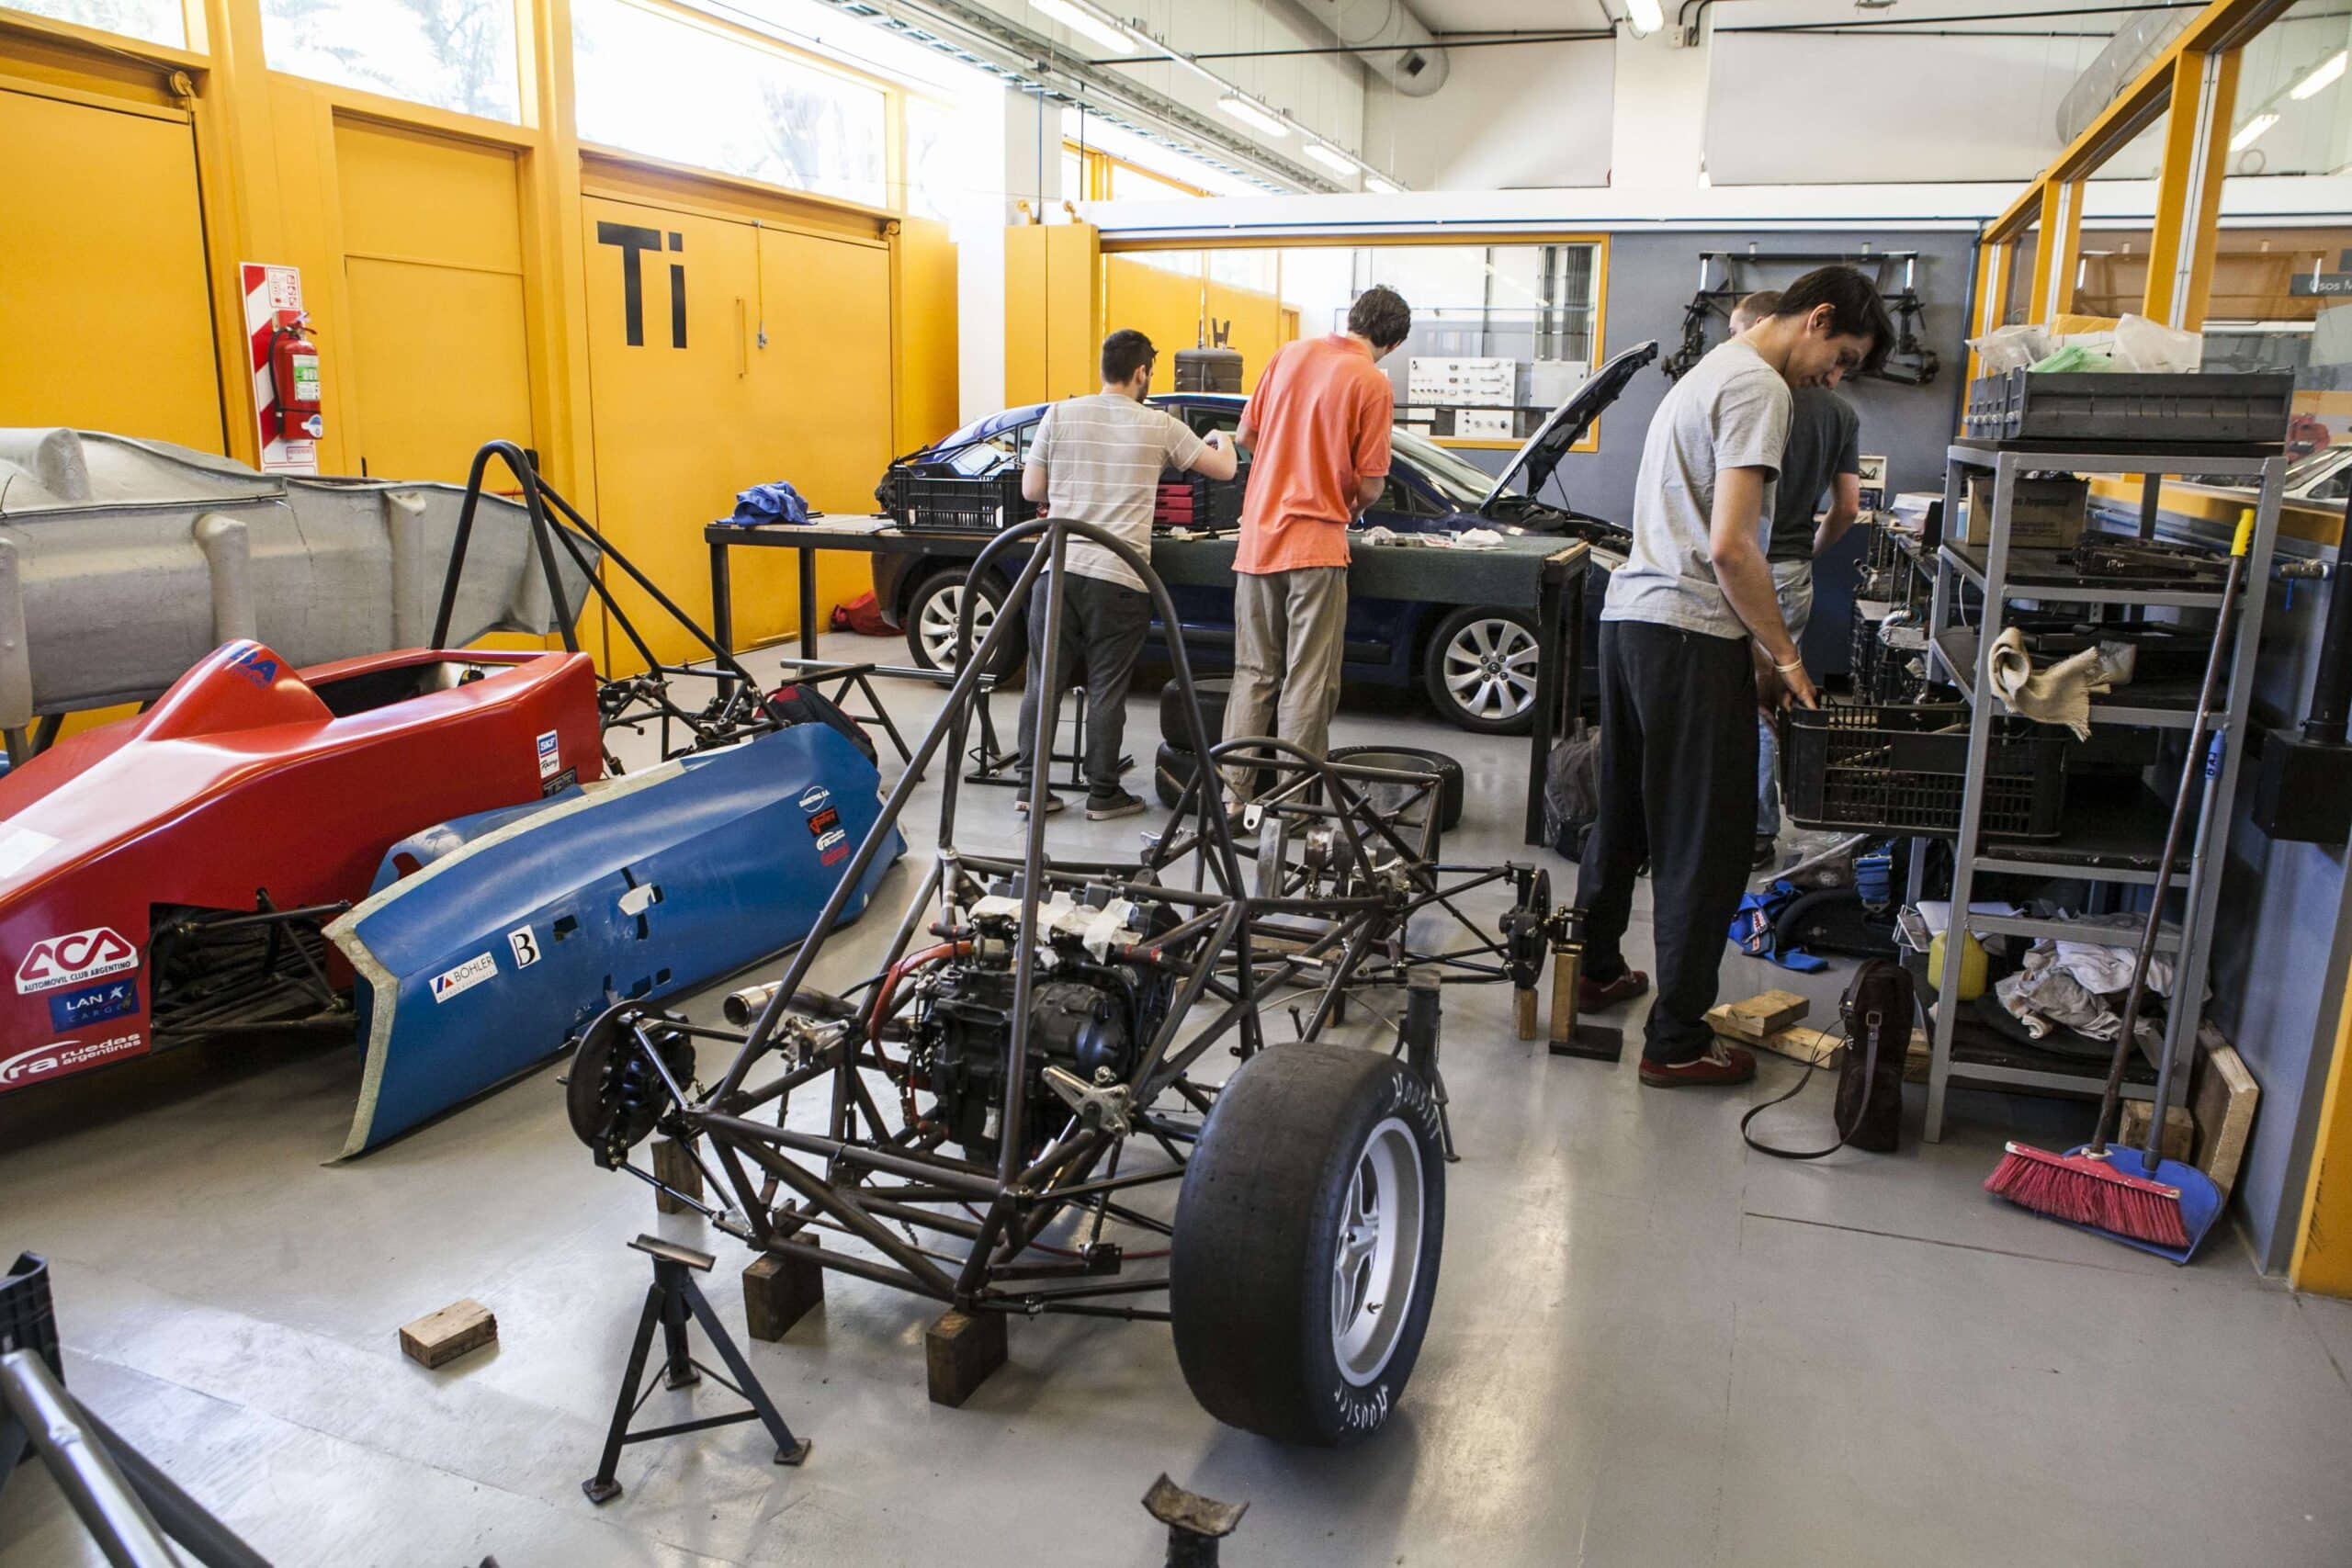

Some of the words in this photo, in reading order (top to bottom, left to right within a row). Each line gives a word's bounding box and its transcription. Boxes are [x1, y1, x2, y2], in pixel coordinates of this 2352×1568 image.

[597, 220, 687, 349] Ti
[540, 738, 556, 751] SKF
[19, 930, 131, 981] ACA
[513, 933, 536, 966] B
[24, 976, 68, 992] AUTOMOVIL
[70, 970, 89, 981] CLUB
[91, 961, 131, 976] ARGENTINO
[66, 994, 103, 1010] LAN
[61, 1033, 141, 1059] ruedas
[62, 1040, 141, 1066] argentinas
